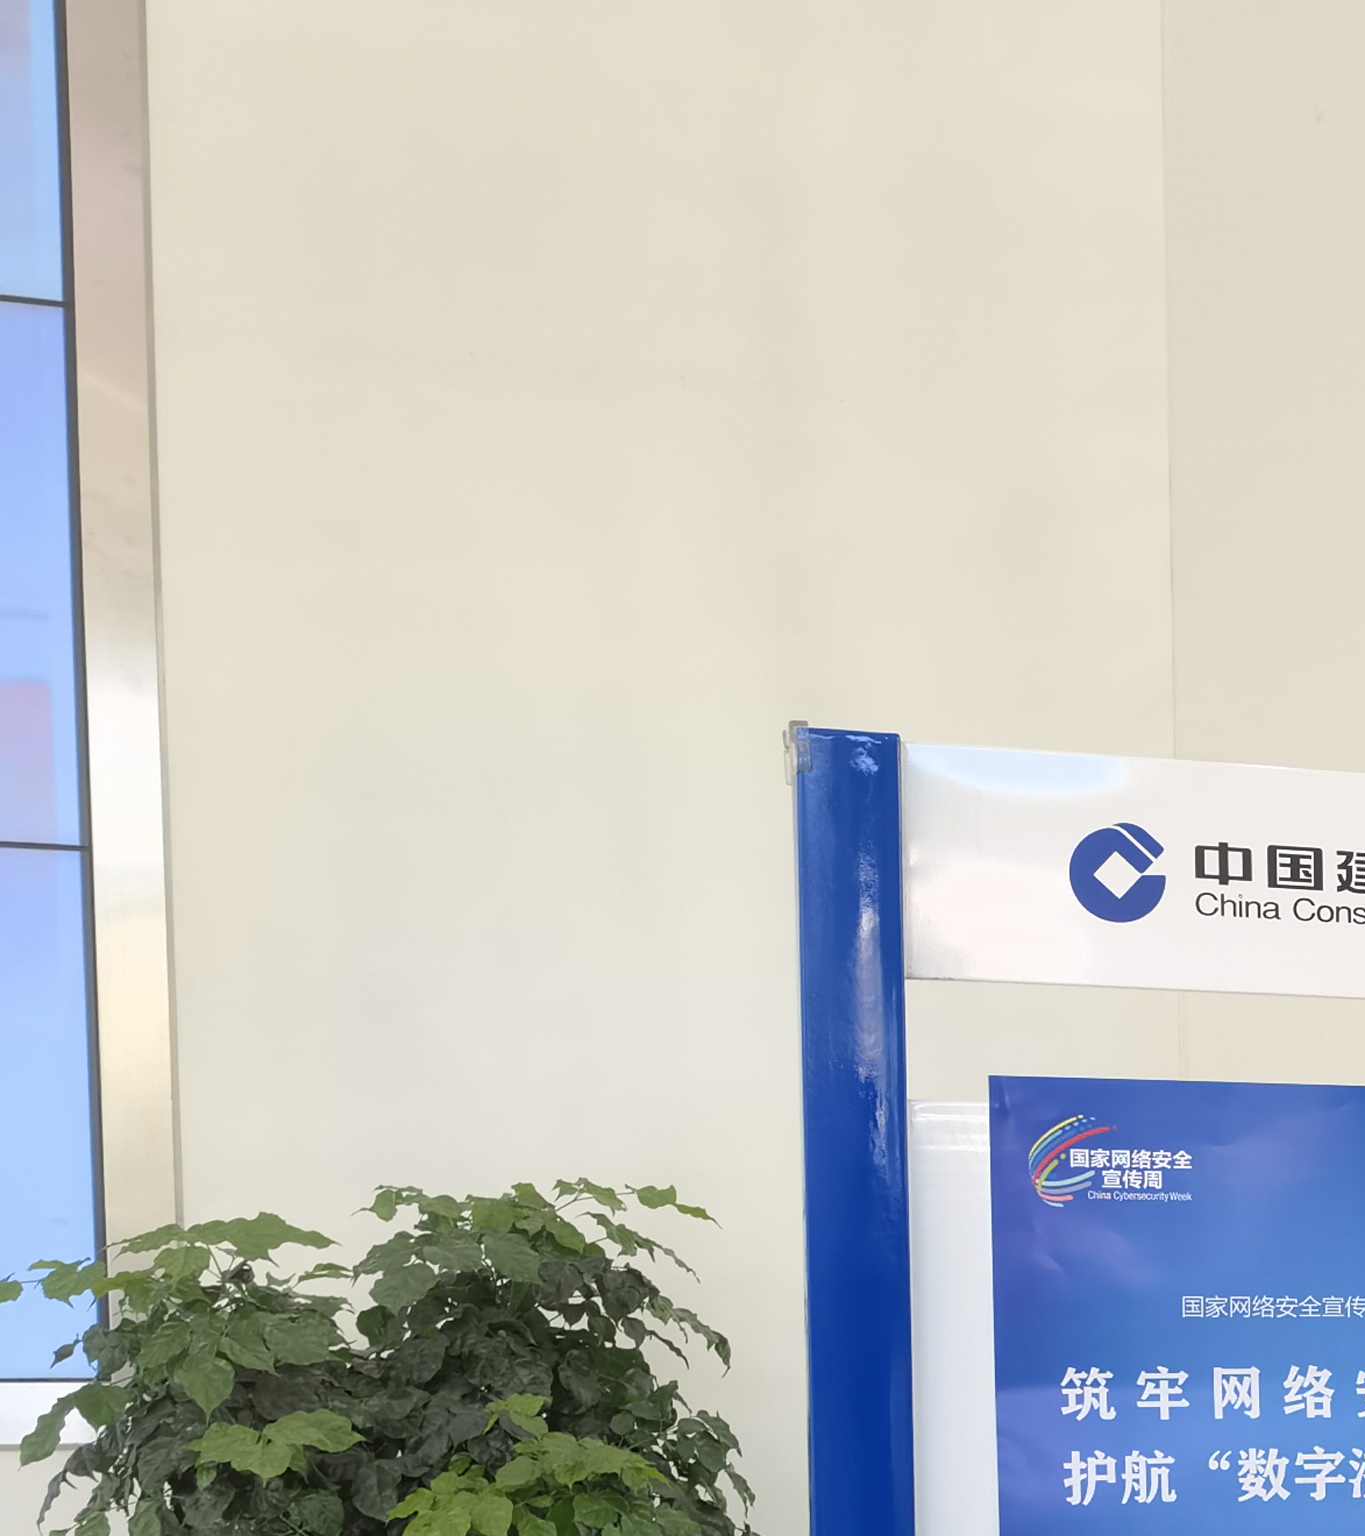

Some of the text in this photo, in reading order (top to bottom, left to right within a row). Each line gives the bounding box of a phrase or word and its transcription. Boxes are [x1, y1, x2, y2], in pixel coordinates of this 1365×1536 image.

[1196, 892, 1280, 920] China
[1070, 1149, 1192, 1169] 国家网络安全
[1102, 1170, 1162, 1189] 宣传周
[1088, 1190, 1192, 1202] China Cybersecurity Week
